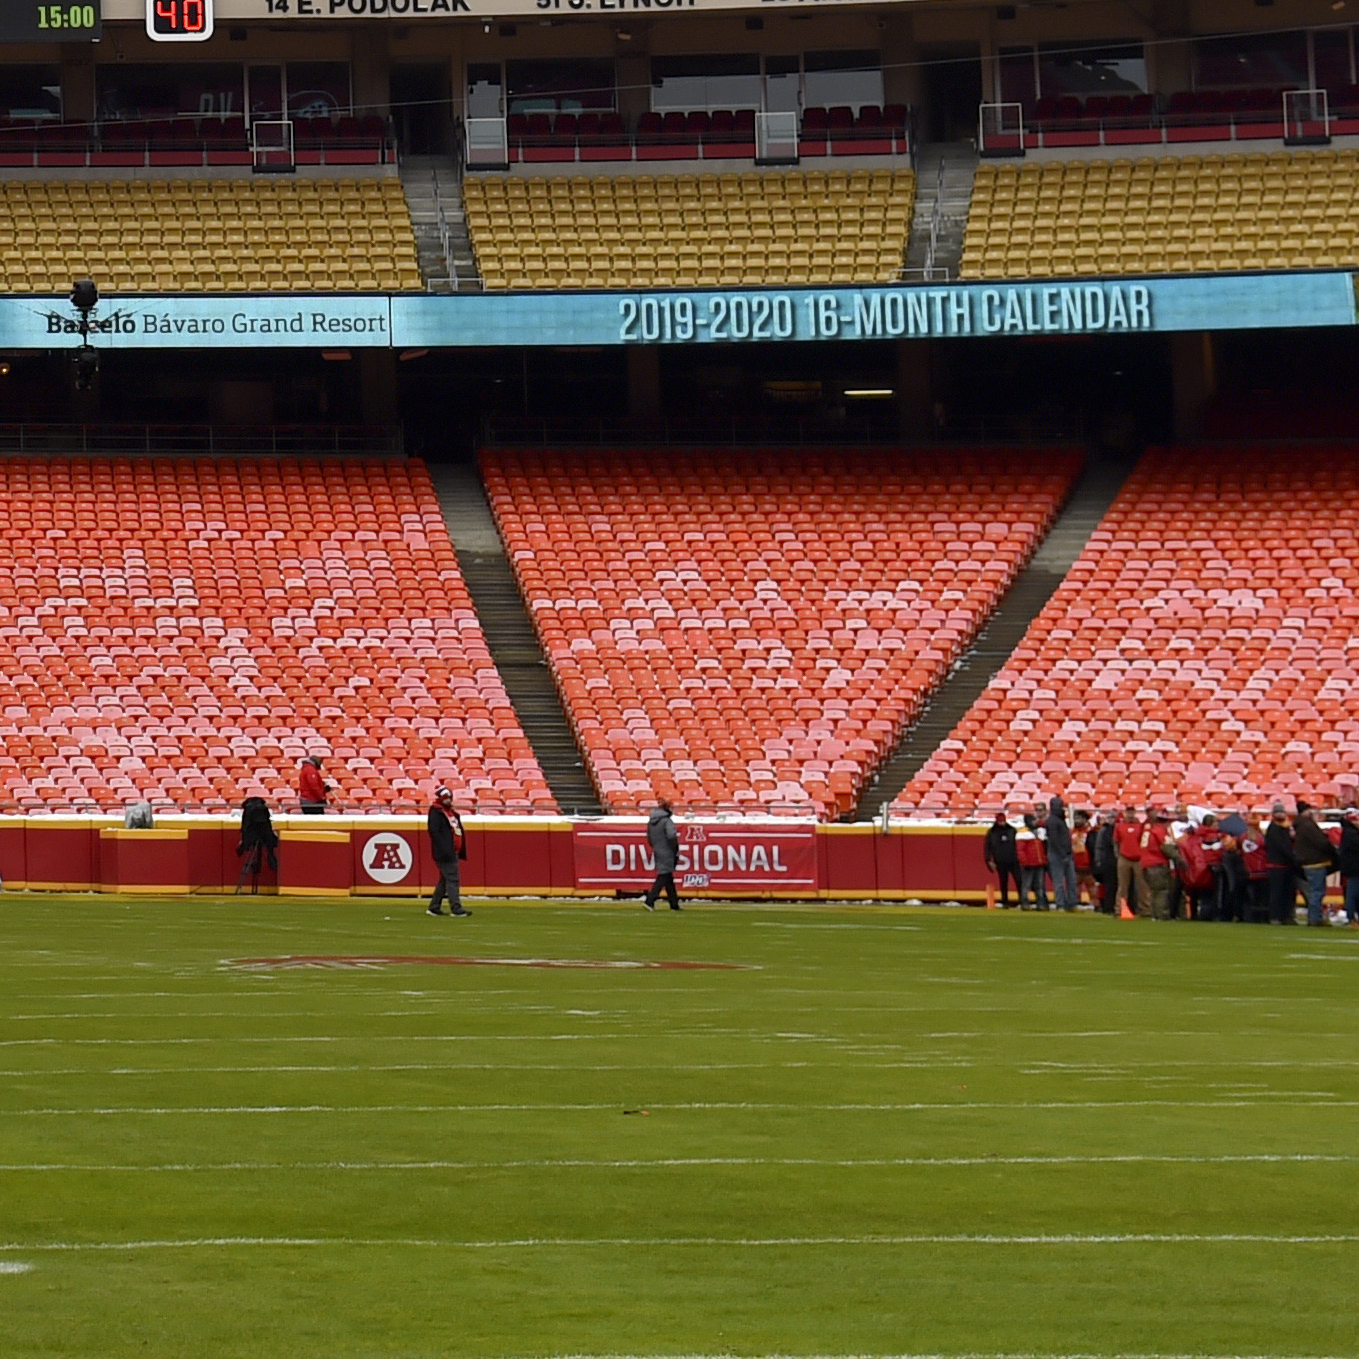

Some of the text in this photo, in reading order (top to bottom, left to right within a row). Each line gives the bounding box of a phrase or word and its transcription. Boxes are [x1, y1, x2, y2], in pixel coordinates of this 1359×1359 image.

[37, 5, 95, 29] 15:00
[142, 313, 225, 334] Bávaro
[231, 313, 305, 334] Grand
[310, 312, 386, 333] Resort
[618, 285, 1152, 341] 2019-2020 16-MONTH CALENDAR
[605, 843, 788, 872] DIVSIONAL
